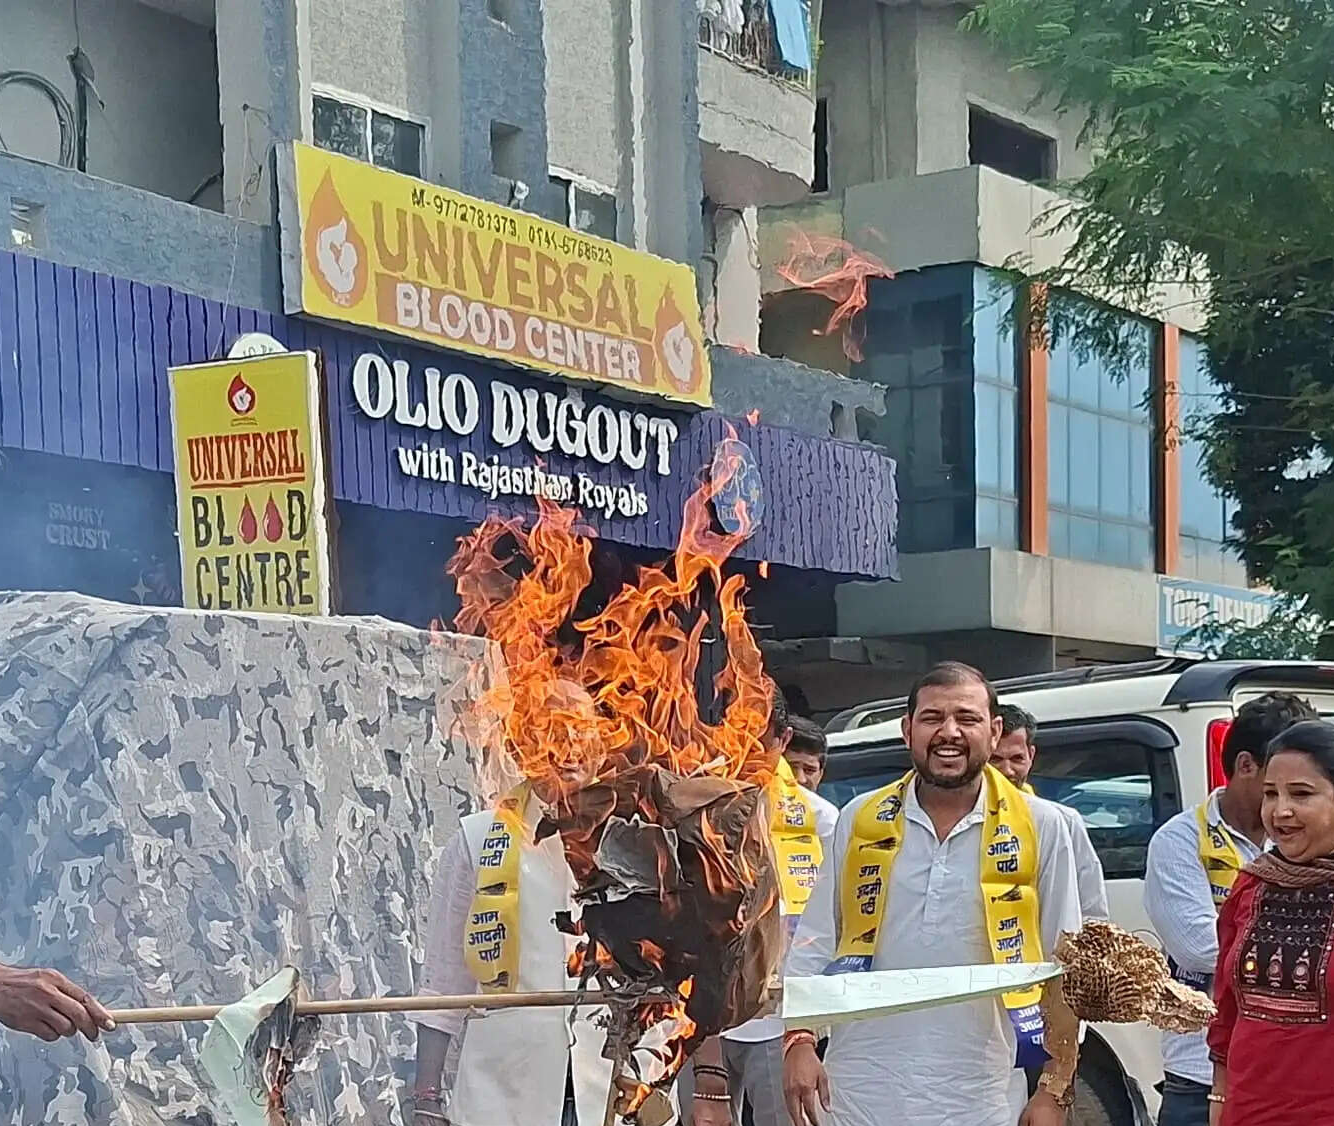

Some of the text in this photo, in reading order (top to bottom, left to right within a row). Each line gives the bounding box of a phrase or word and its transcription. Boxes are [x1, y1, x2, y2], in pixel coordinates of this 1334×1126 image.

[372, 201, 655, 343] UNIVERSAL
[396, 283, 643, 383] BLOOD CENTER
[352, 353, 679, 475] OLIO DUGOUT
[187, 429, 305, 482] UNIVERSAL
[398, 442, 649, 520] with Rajasthan Royals
[196, 550, 313, 611] CENTRE
[468, 922, 506, 946] आदमी
[472, 910, 500, 925] आम
